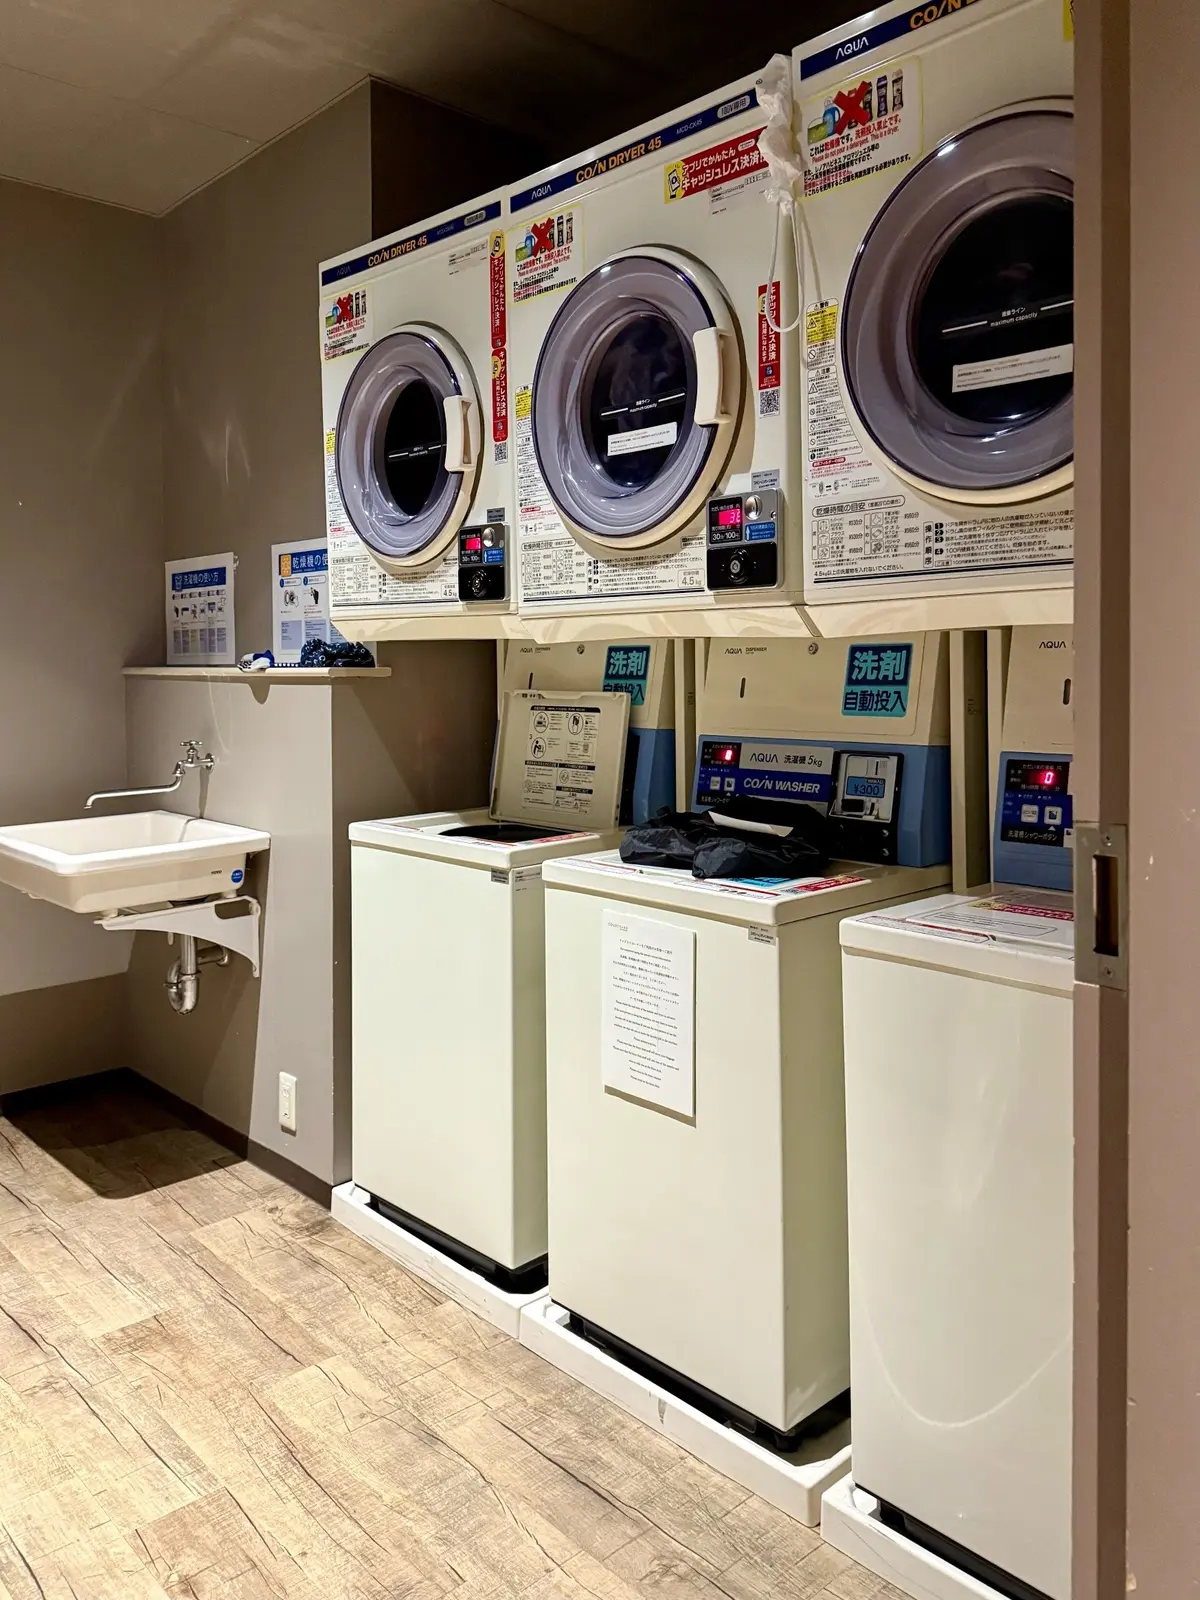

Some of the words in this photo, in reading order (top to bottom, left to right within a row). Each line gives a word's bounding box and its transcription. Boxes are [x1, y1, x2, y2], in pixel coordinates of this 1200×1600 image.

[835, 36, 869, 60] AQUA
[531, 185, 552, 199] AQUA
[576, 159, 607, 183] COIN
[608, 147, 645, 169] DRYER
[648, 136, 662, 151] 45
[683, 147, 736, 175] アプリでかんたん
[391, 240, 416, 259] DRYER
[418, 235, 428, 247] 45
[990, 318, 1015, 327] maximum
[1016, 312, 1038, 322] capacity
[184, 572, 219, 585] 洗濯機の使い方
[1039, 641, 1067, 649] AQUA
[608, 651, 646, 675] 洗剤
[851, 650, 906, 680] 洗剤
[843, 690, 906, 712] 自動投入
[749, 753, 779, 763] AQUA
[783, 755, 806, 765] 洗濯機
[807, 755, 823, 767] 5kg
[775, 780, 820, 793] WASHER
[1044, 771, 1054, 784] 0
[854, 783, 880, 796] ¥300
